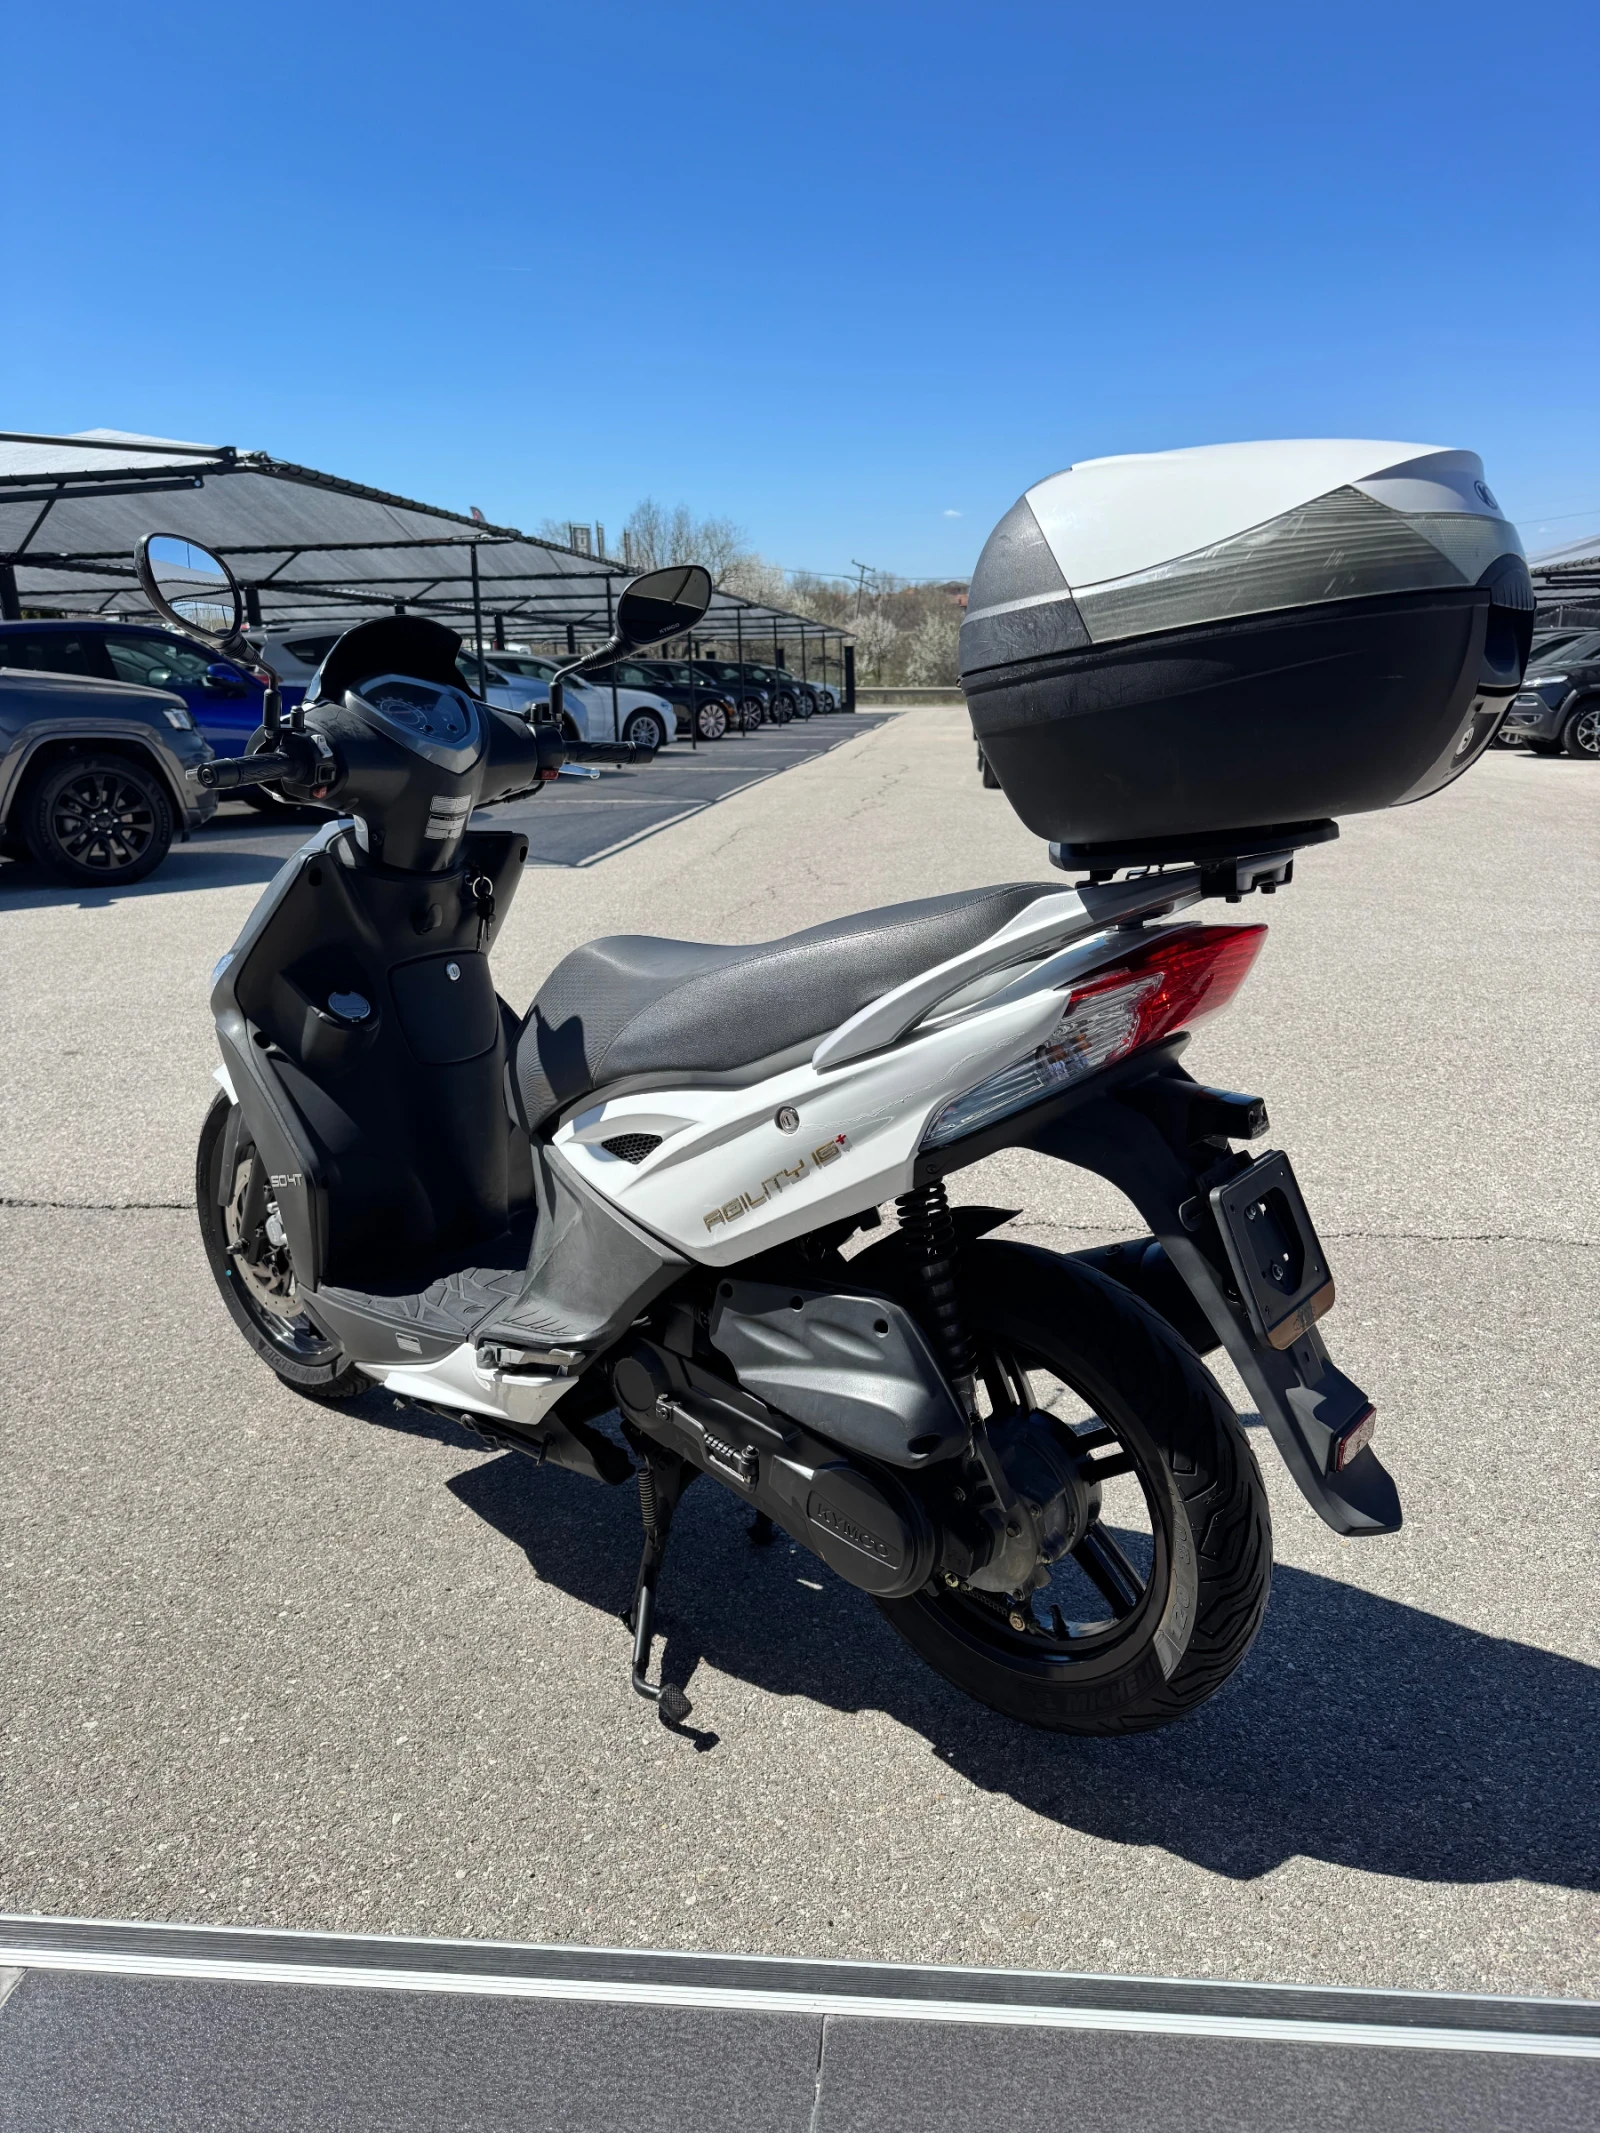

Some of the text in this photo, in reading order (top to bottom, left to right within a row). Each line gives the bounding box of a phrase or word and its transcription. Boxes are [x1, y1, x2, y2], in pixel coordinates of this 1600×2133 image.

[659, 622, 681, 635] KYMCO
[703, 1159, 806, 1232] AGILITY
[817, 1503, 891, 1558] KYMCO
